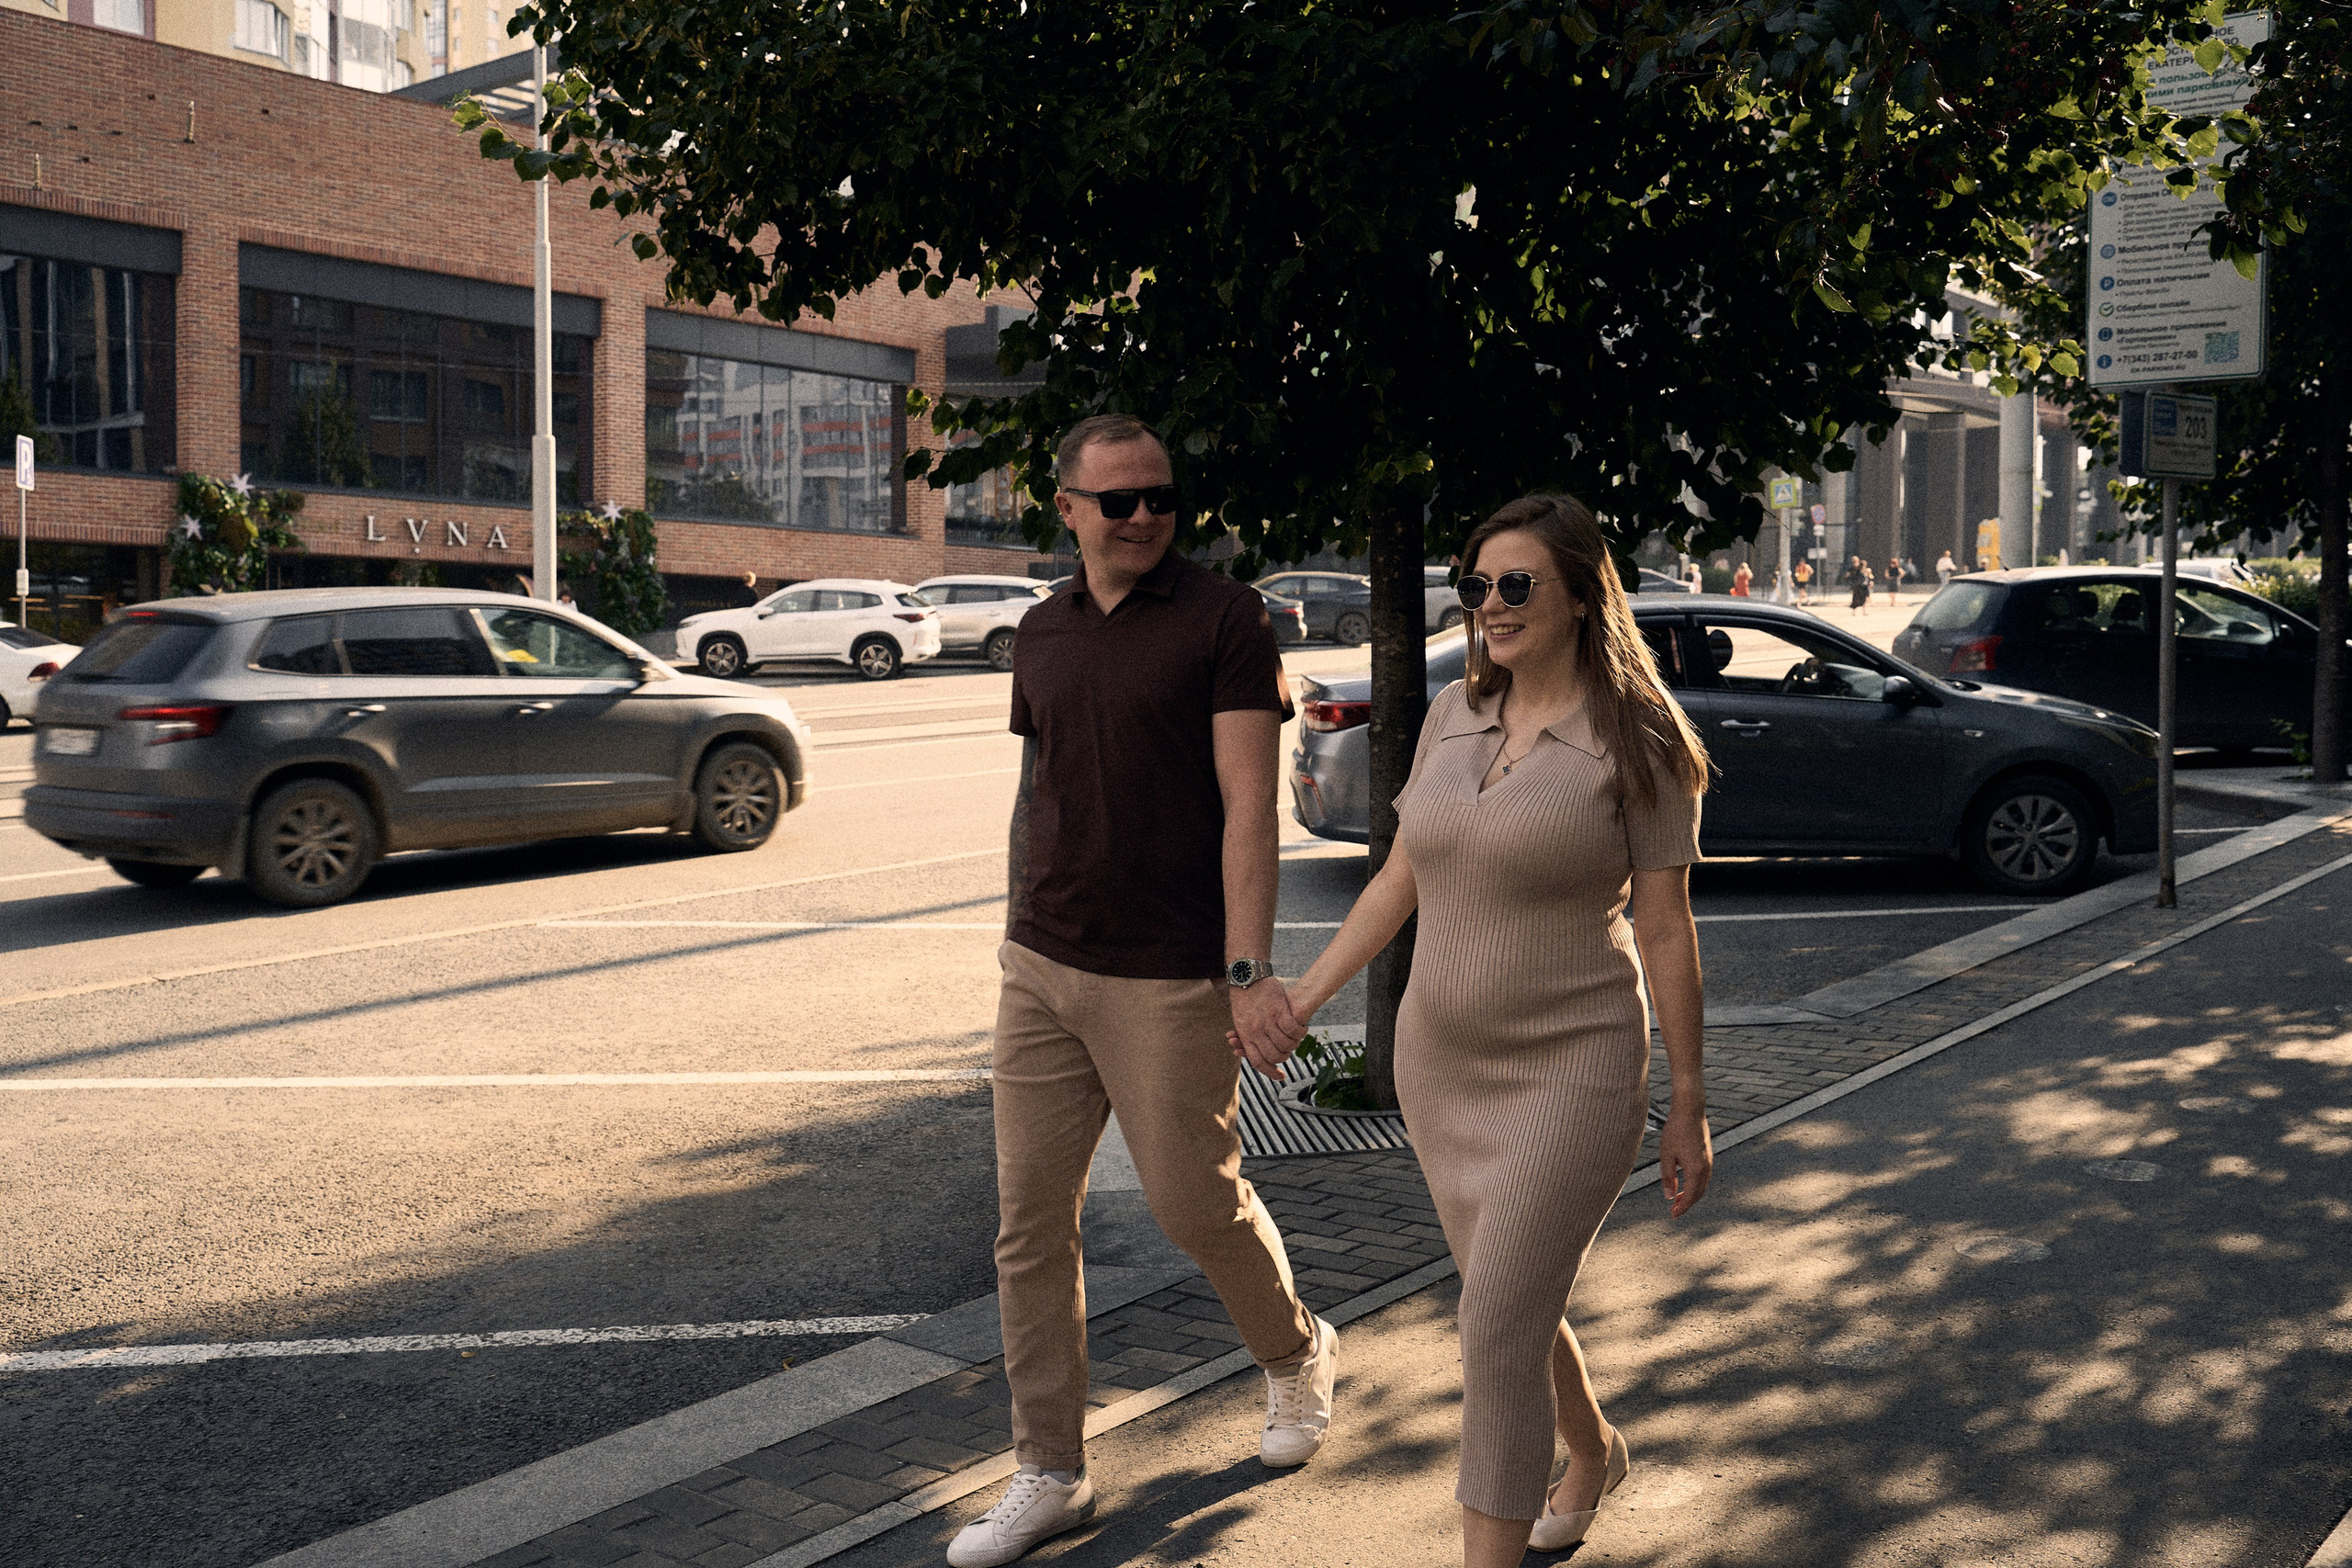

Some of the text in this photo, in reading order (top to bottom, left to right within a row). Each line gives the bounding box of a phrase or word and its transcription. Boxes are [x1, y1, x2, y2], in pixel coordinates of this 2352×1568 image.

[2147, 56, 2195, 70] ЕКАТЕРИ
[2117, 278, 2151, 287] Оплата
[2186, 415, 2206, 439] 203
[20, 441, 31, 483] P
